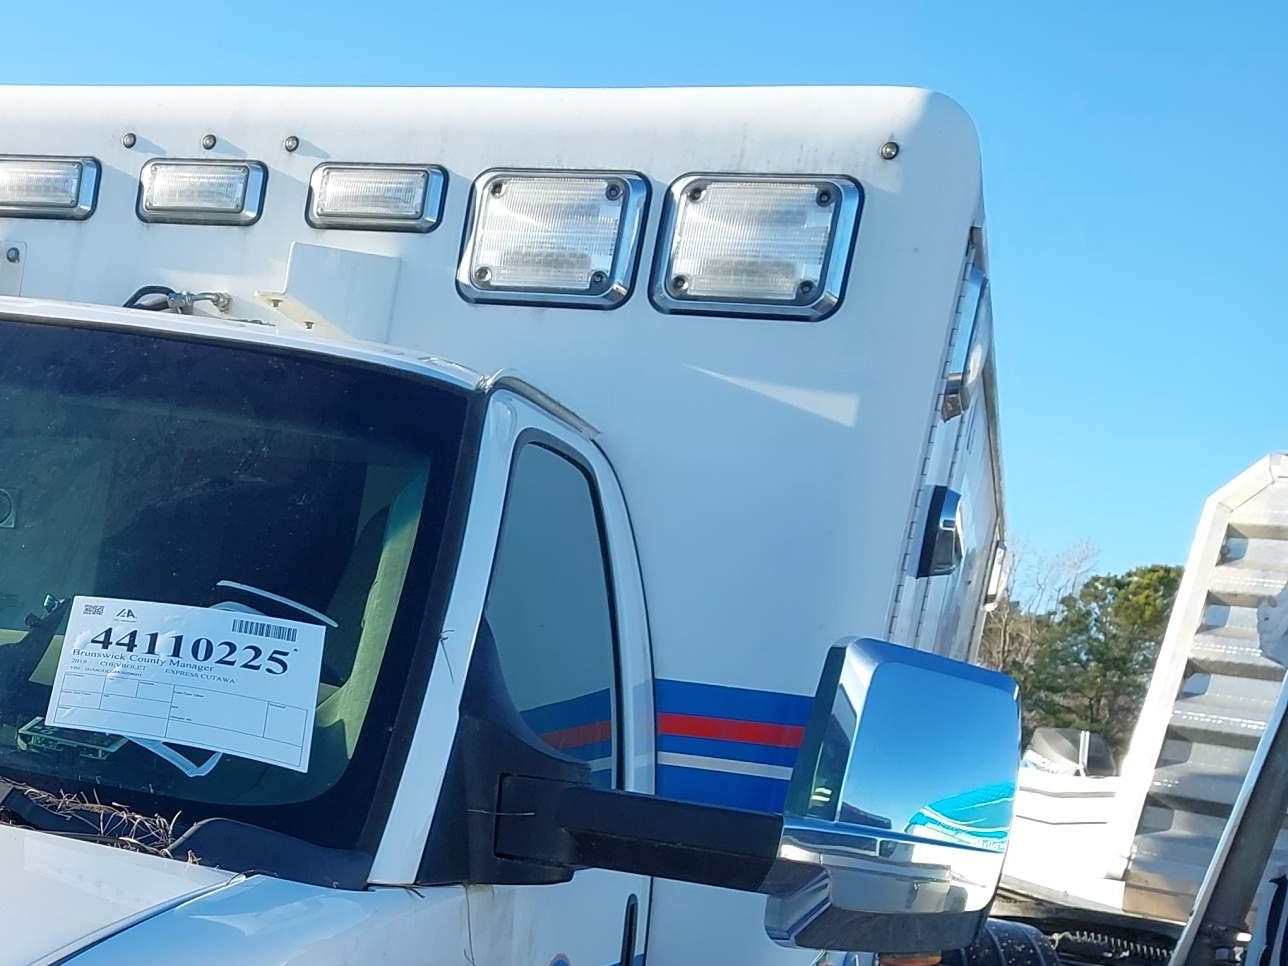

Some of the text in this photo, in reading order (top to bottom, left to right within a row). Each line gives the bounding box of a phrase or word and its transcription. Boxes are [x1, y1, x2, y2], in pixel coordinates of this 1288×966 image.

[72, 648, 216, 674] Brunswick County Manager
[90, 626, 291, 675] 44110225
[99, 659, 148, 672] CHEVROLET
[165, 668, 200, 680] EXPRESS
[200, 673, 236, 685] CUTAWA
